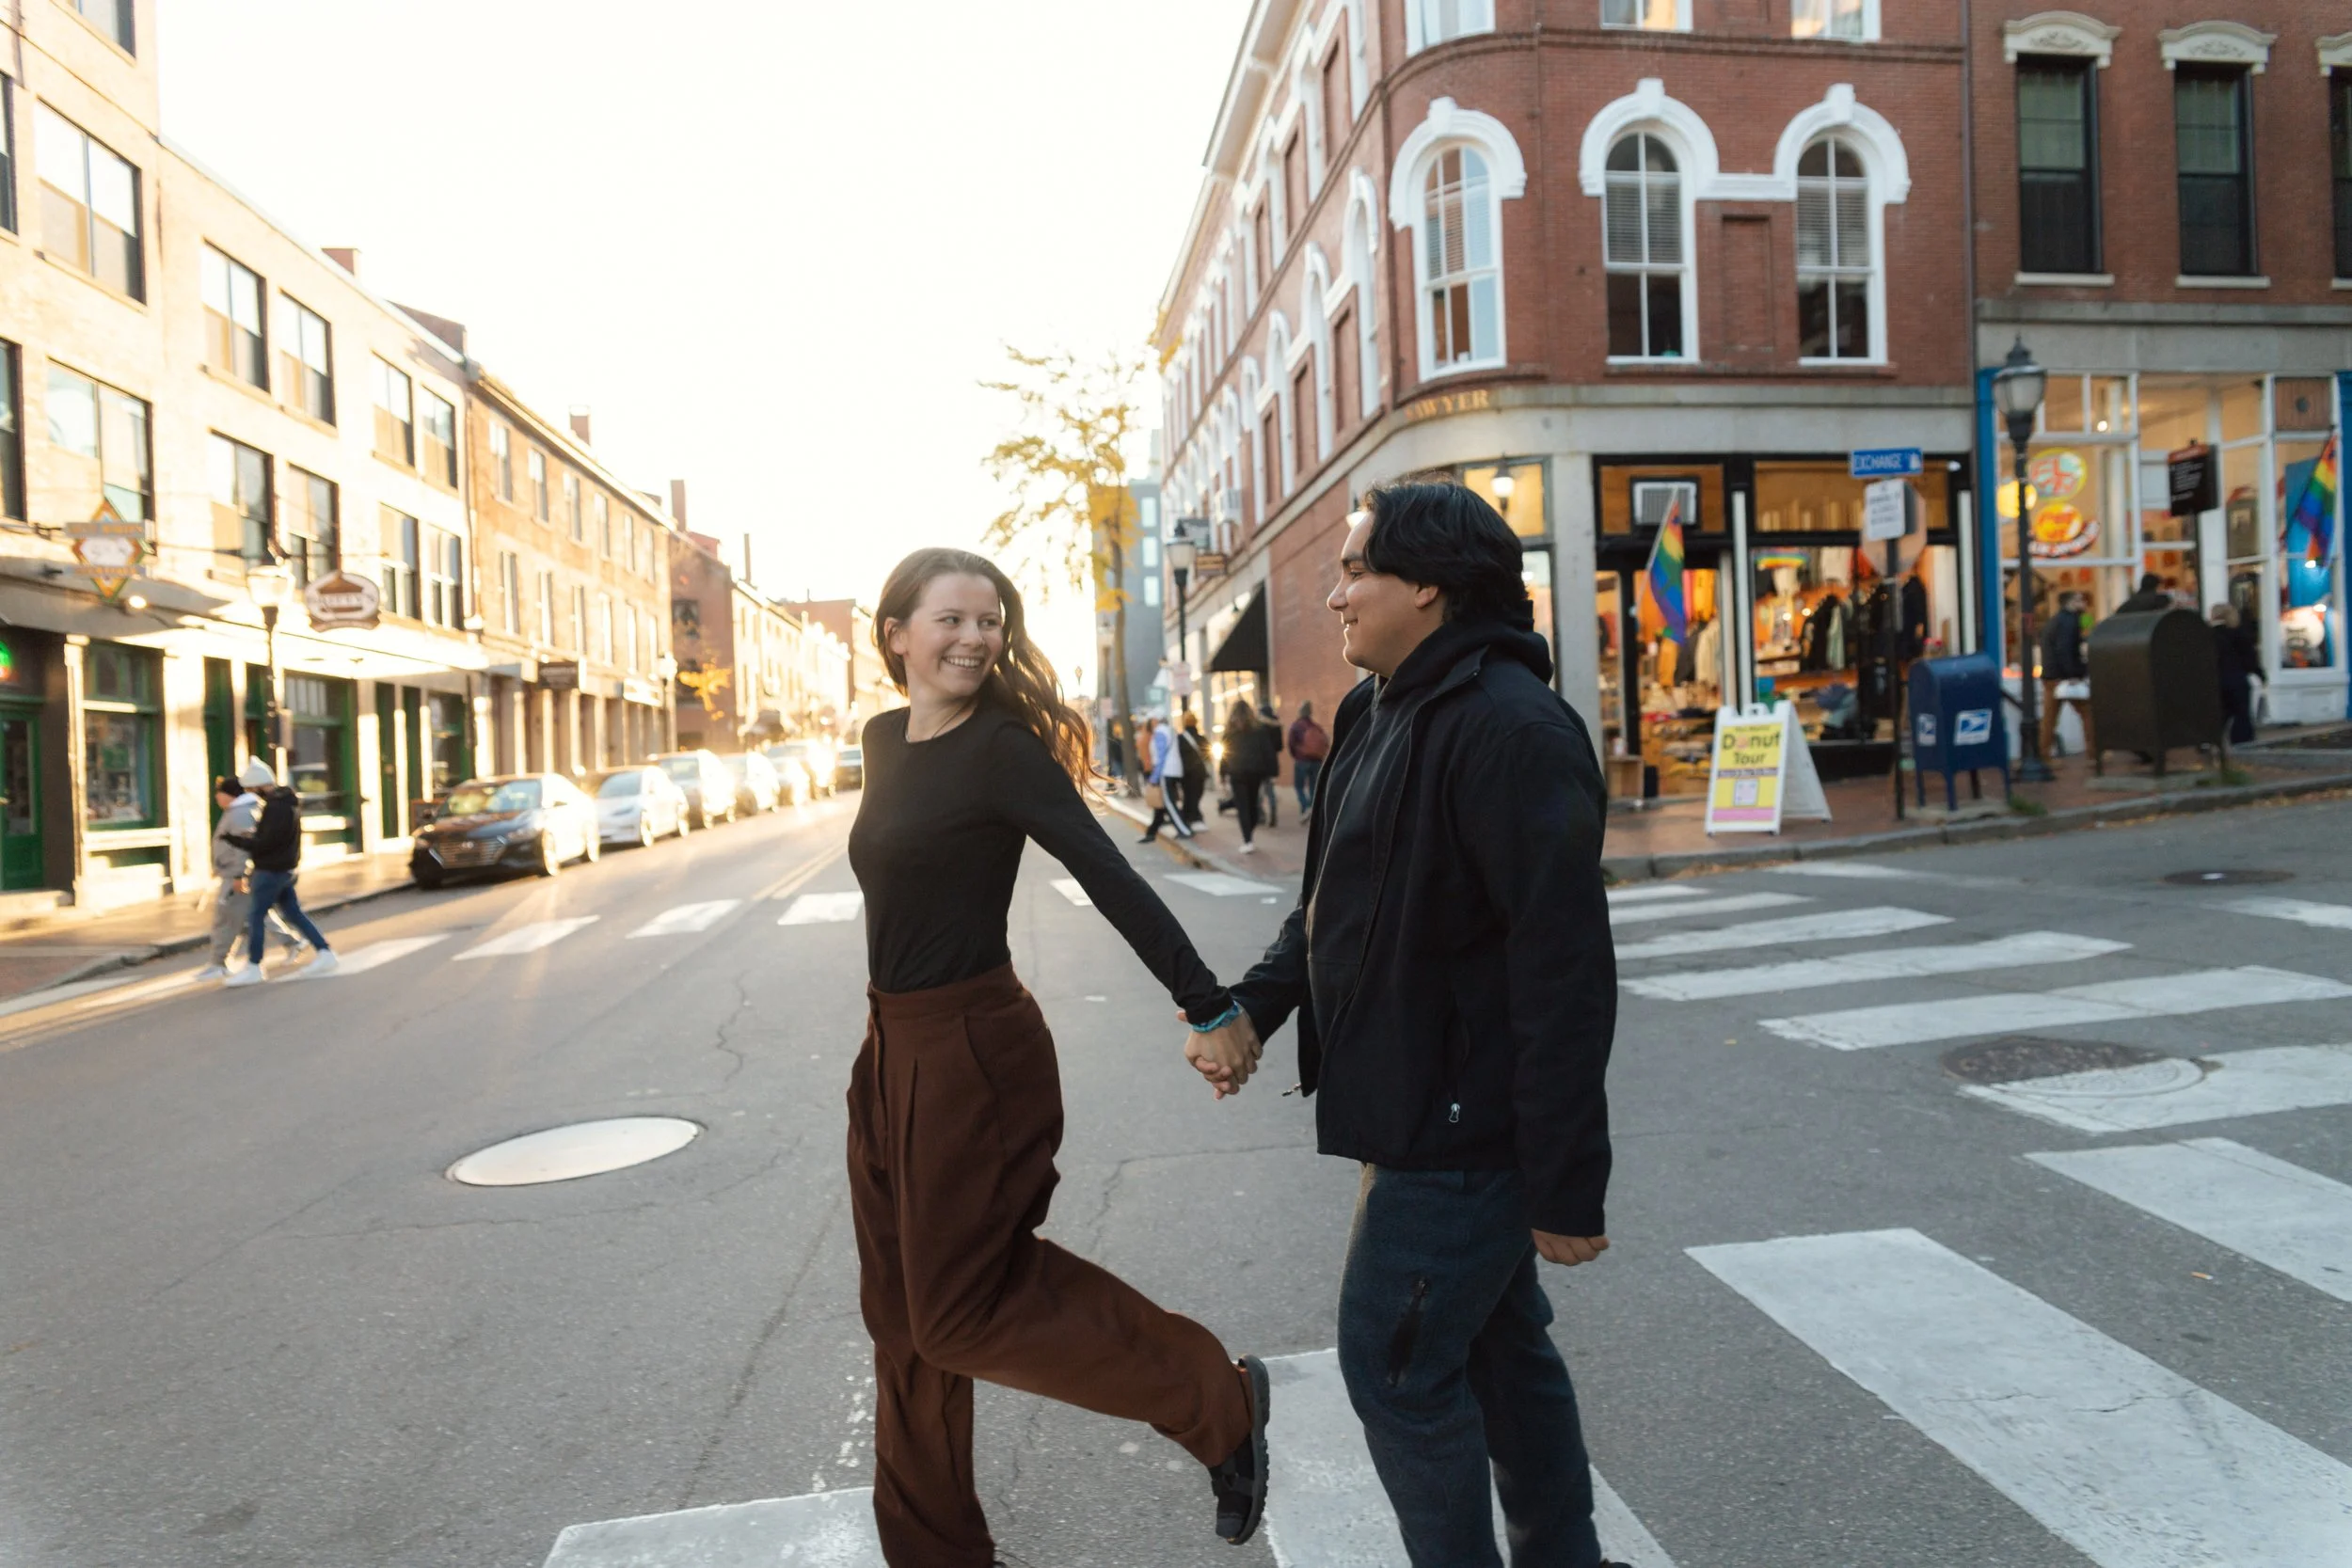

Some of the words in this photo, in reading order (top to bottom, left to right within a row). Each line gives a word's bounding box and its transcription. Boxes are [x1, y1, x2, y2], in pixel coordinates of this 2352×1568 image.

[1852, 453, 1901, 470] EXCHANGE
[1723, 731, 1781, 750] Donut
[1734, 752, 1766, 765] Tour
